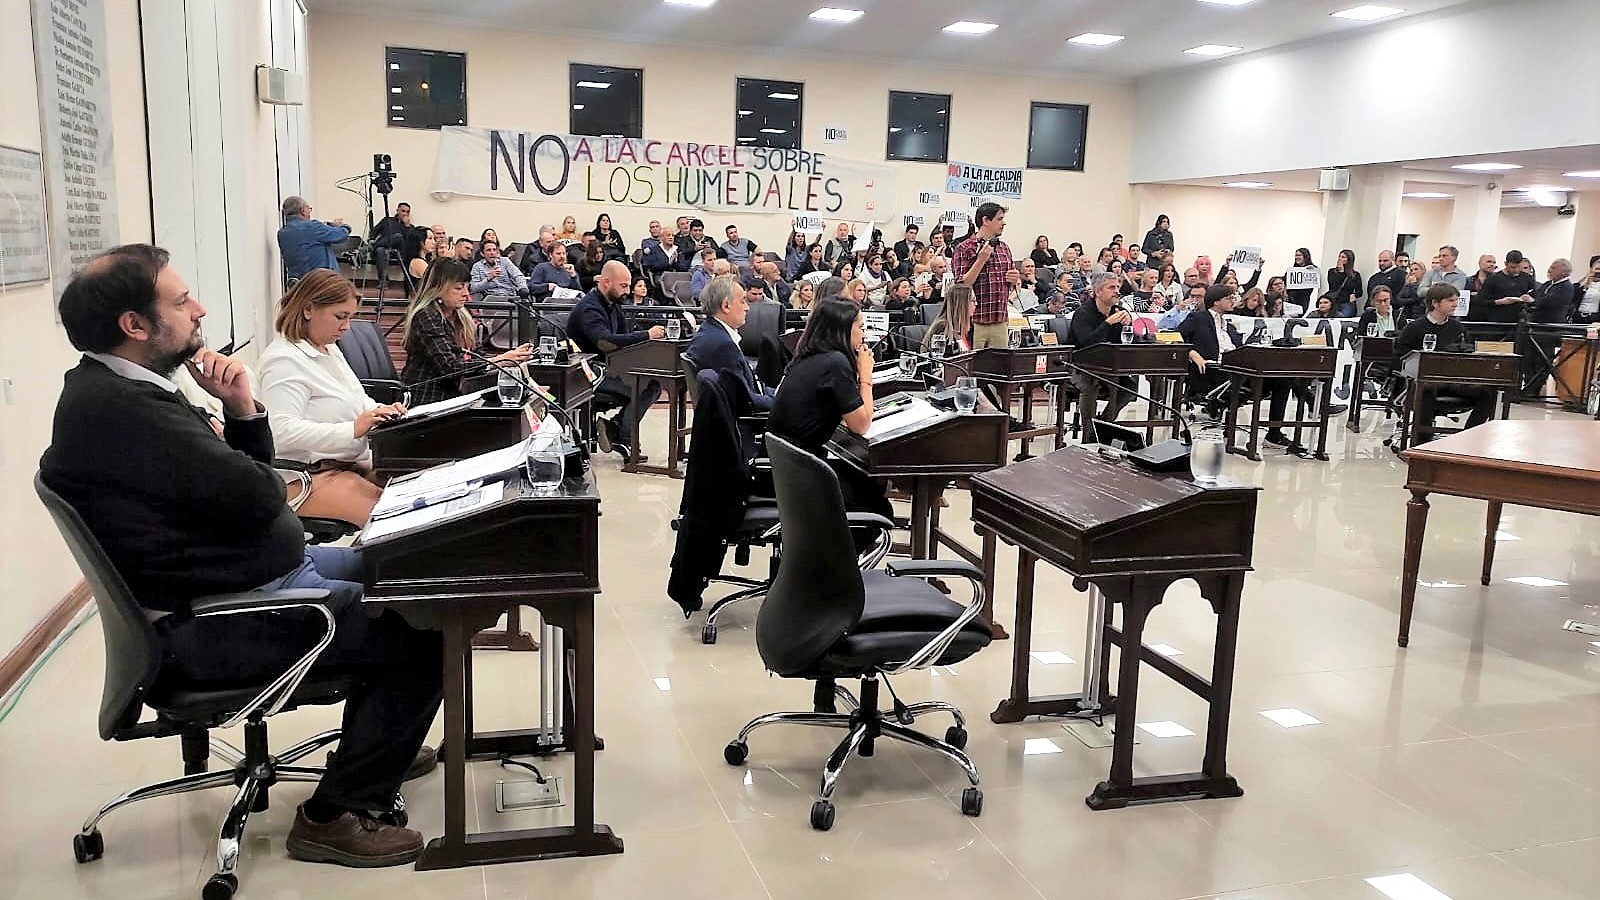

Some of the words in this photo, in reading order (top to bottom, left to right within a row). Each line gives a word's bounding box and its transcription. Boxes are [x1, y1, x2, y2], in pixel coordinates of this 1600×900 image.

[826, 128, 836, 140] NO
[490, 130, 571, 196] NO
[573, 138, 594, 163] A
[605, 139, 638, 164] LA
[645, 142, 745, 168] CARCEL
[752, 148, 826, 175] SOBRE
[949, 164, 961, 178] NO
[963, 167, 969, 178] A
[972, 168, 982, 180] LA
[587, 165, 654, 205] LOS
[666, 167, 842, 213] HUMEDALES
[969, 181, 995, 194] DIQUE
[919, 192, 930, 204] NO
[796, 216, 808, 229] NO
[945, 210, 956, 222] NO
[1232, 249, 1247, 264] NO
[1290, 271, 1303, 285] NO
